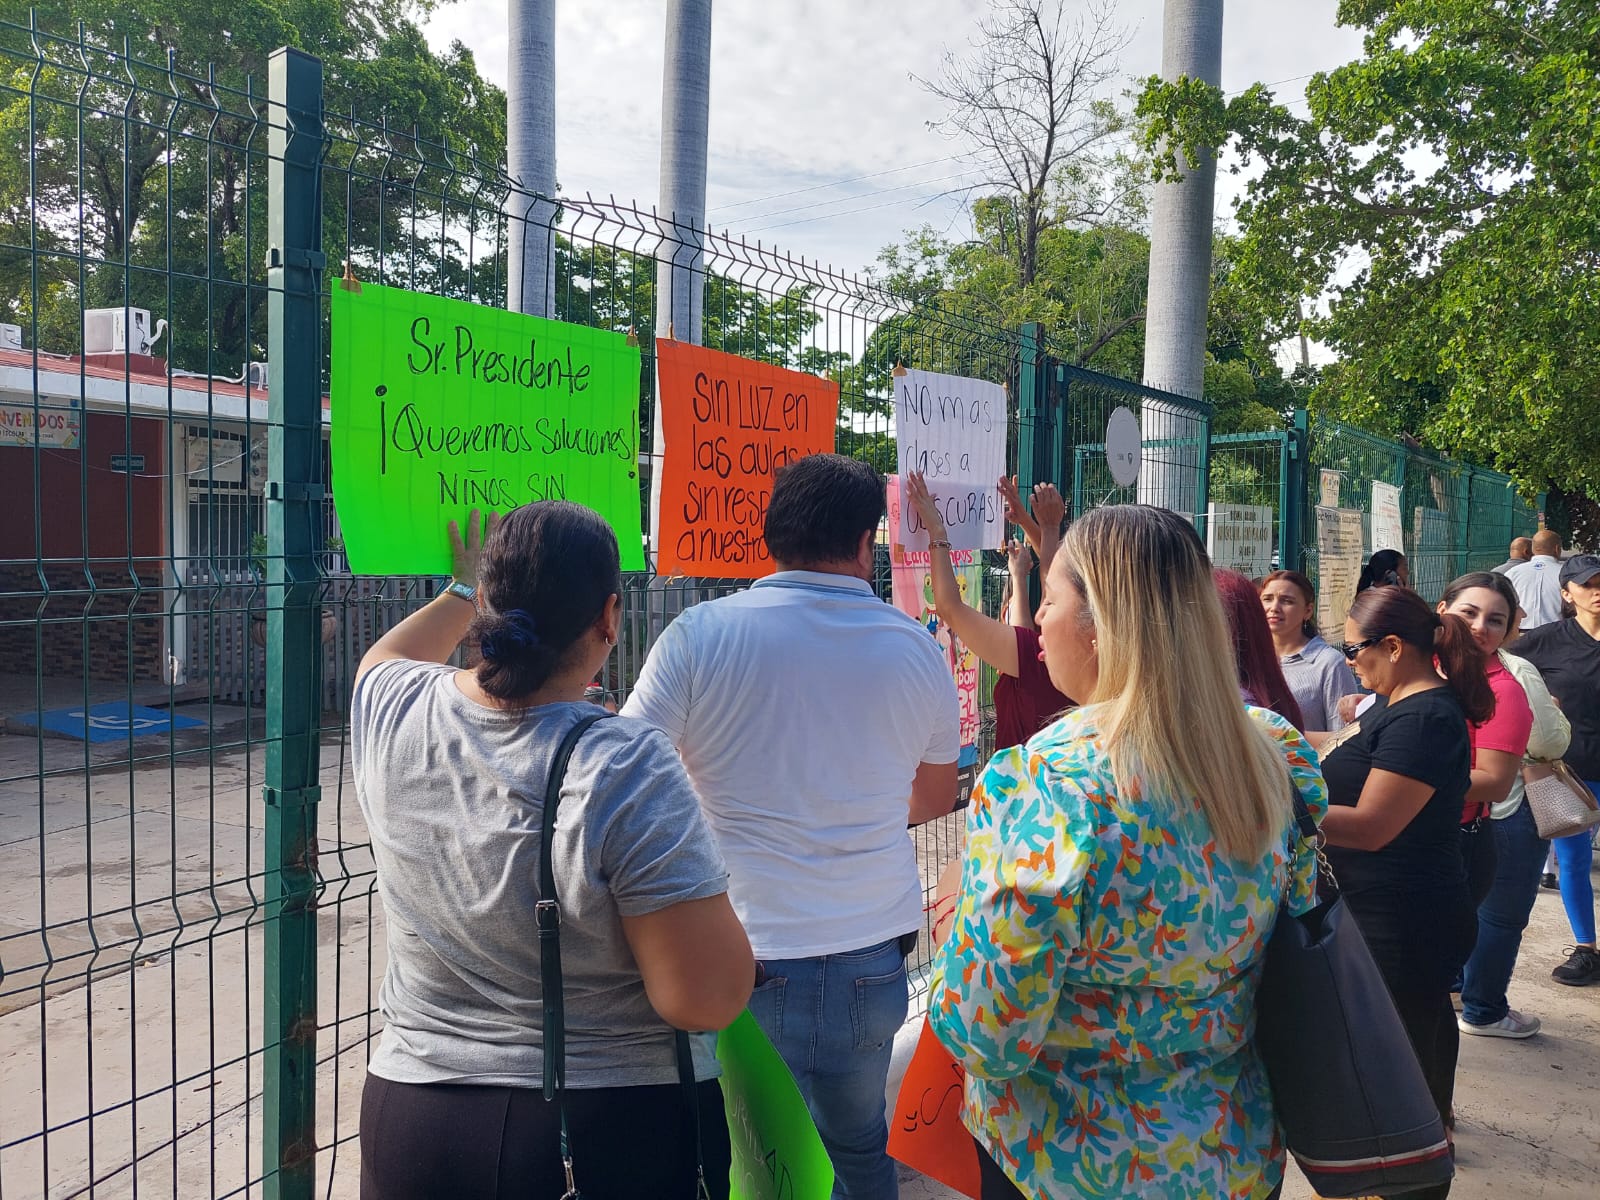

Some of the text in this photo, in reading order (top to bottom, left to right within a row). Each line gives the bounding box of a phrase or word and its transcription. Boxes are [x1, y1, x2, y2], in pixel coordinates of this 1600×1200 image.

[407, 317, 591, 397] Sr. Presidente
[737, 379, 781, 432] LUZ
[783, 392, 809, 432] en
[903, 383, 992, 433] NO mas
[692, 424, 732, 479] las
[960, 453, 971, 472] a
[437, 469, 566, 509] NIÑOS SIN
[724, 487, 770, 530] resp
[676, 528, 696, 562] a
